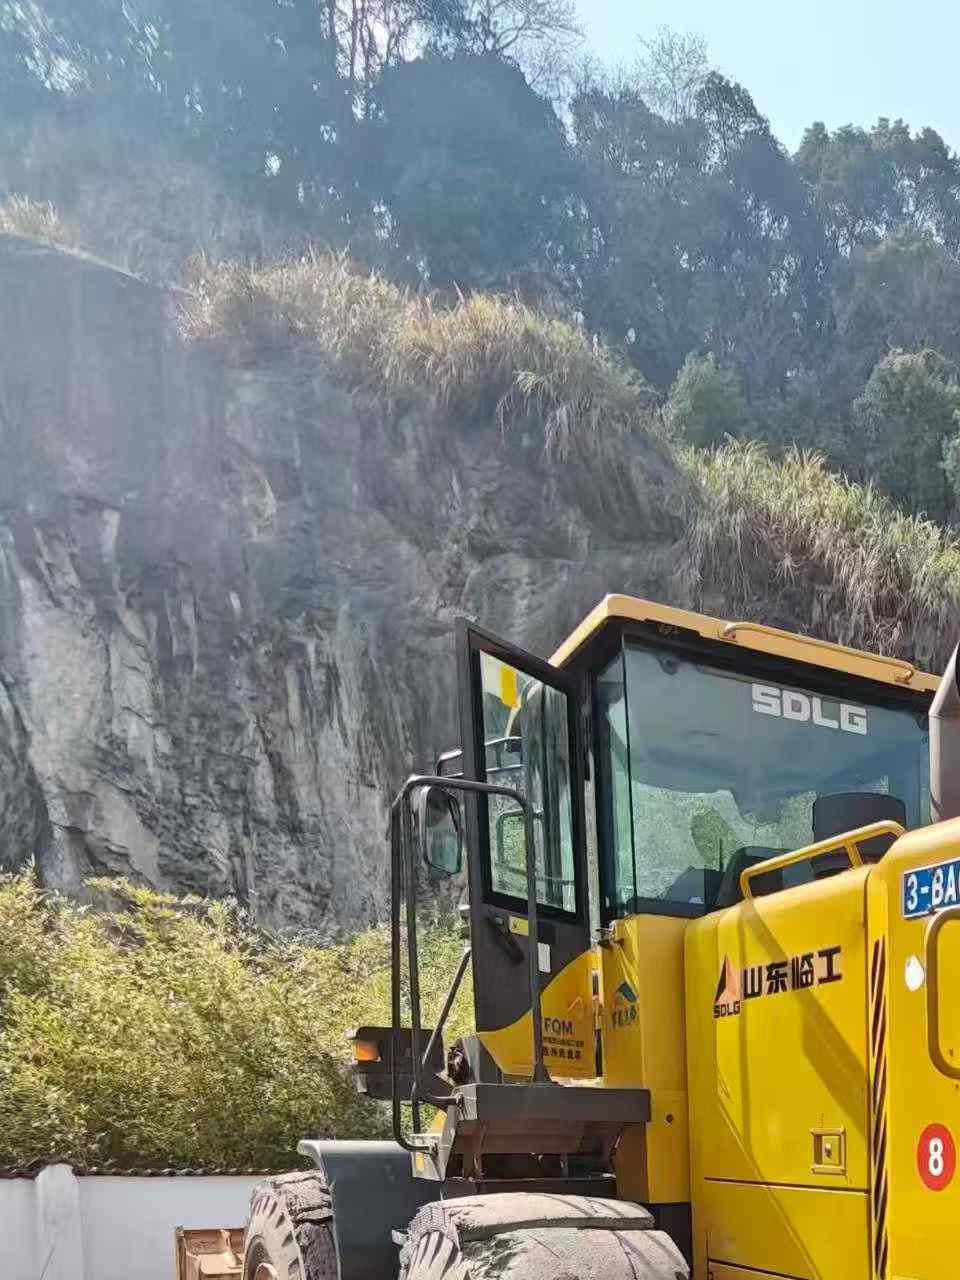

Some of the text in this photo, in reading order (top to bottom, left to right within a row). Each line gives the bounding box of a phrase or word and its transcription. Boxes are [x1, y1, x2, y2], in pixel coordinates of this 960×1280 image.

[751, 683, 868, 735] SDLG
[742, 944, 843, 1000] 山东临工
[713, 1000, 741, 1018] SDLG
[928, 1136, 944, 1177] 8
